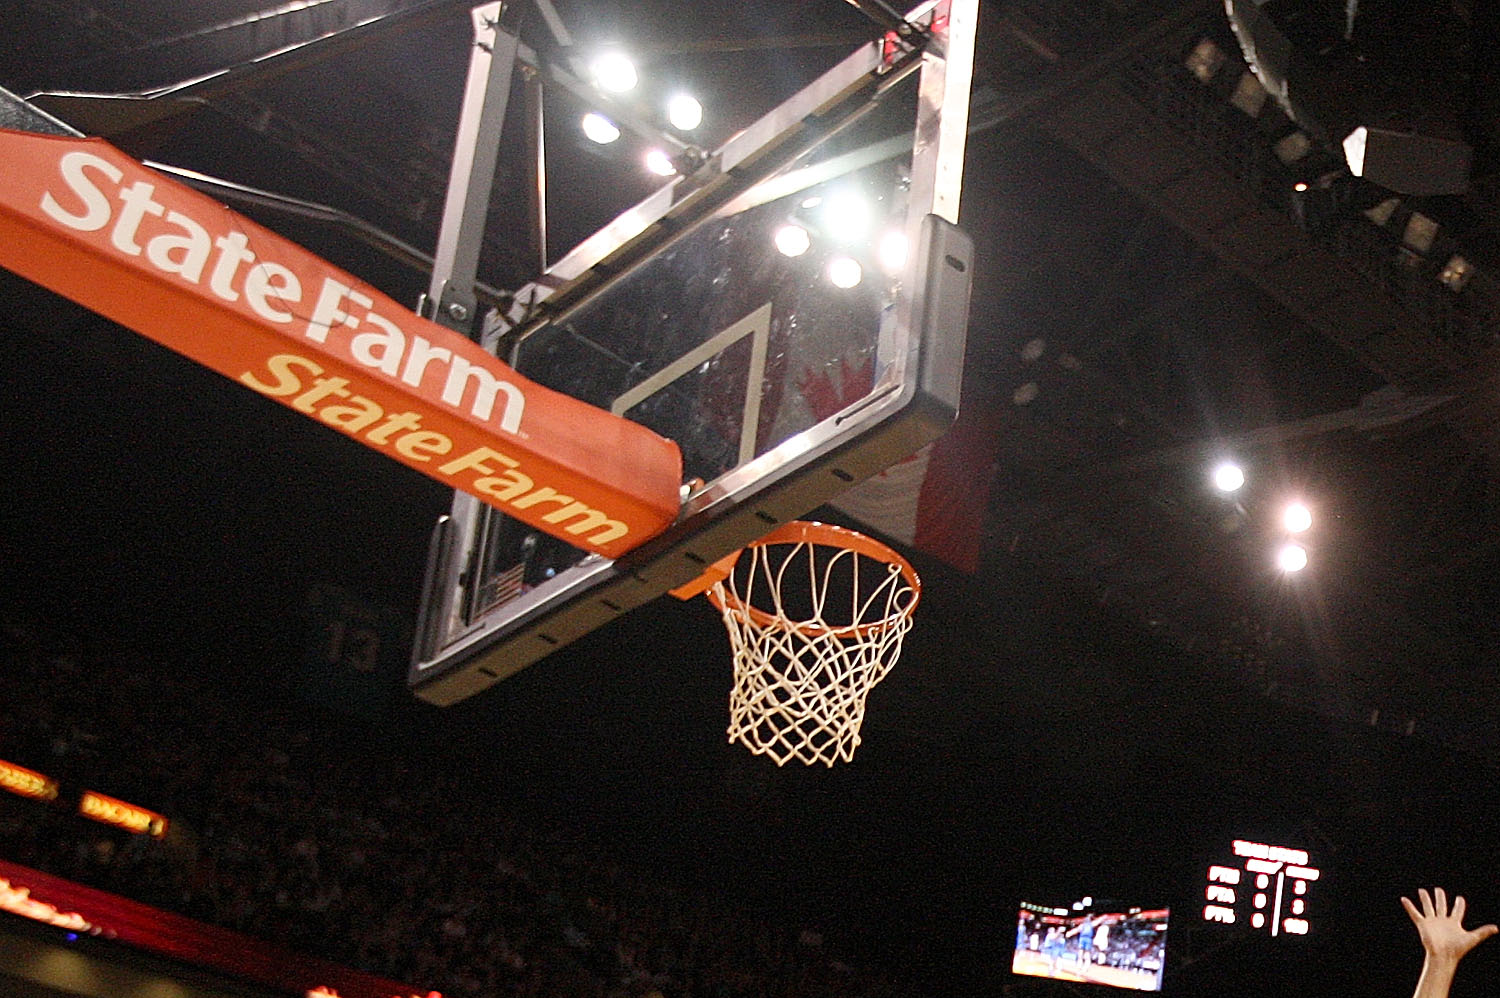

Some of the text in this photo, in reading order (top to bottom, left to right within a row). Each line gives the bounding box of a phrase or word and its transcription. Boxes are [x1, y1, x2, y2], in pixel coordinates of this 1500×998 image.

[40, 151, 526, 435] State Farm
[241, 354, 631, 547] State Farm
